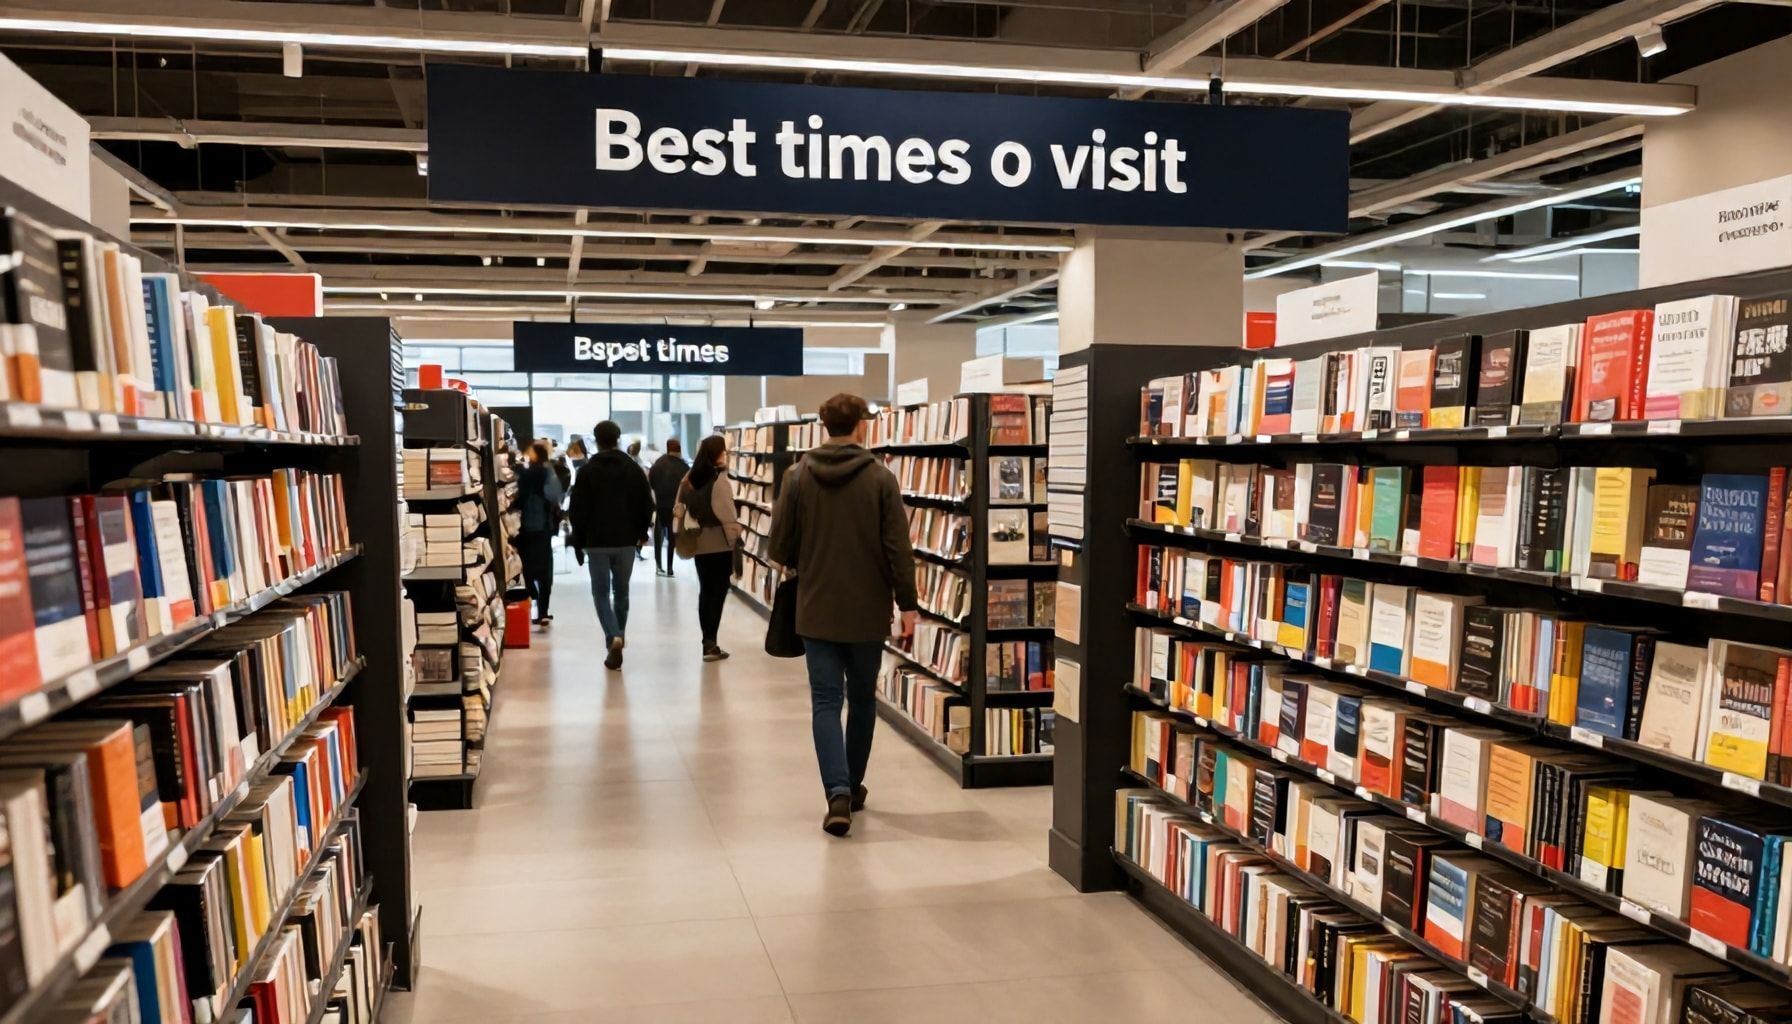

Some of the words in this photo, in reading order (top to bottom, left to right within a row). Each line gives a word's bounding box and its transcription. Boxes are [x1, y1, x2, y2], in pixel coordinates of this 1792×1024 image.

[595, 108, 757, 177] Best
[776, 114, 972, 185] times
[991, 141, 1031, 187] o
[1050, 128, 1188, 194] visit
[657, 337, 729, 363] times
